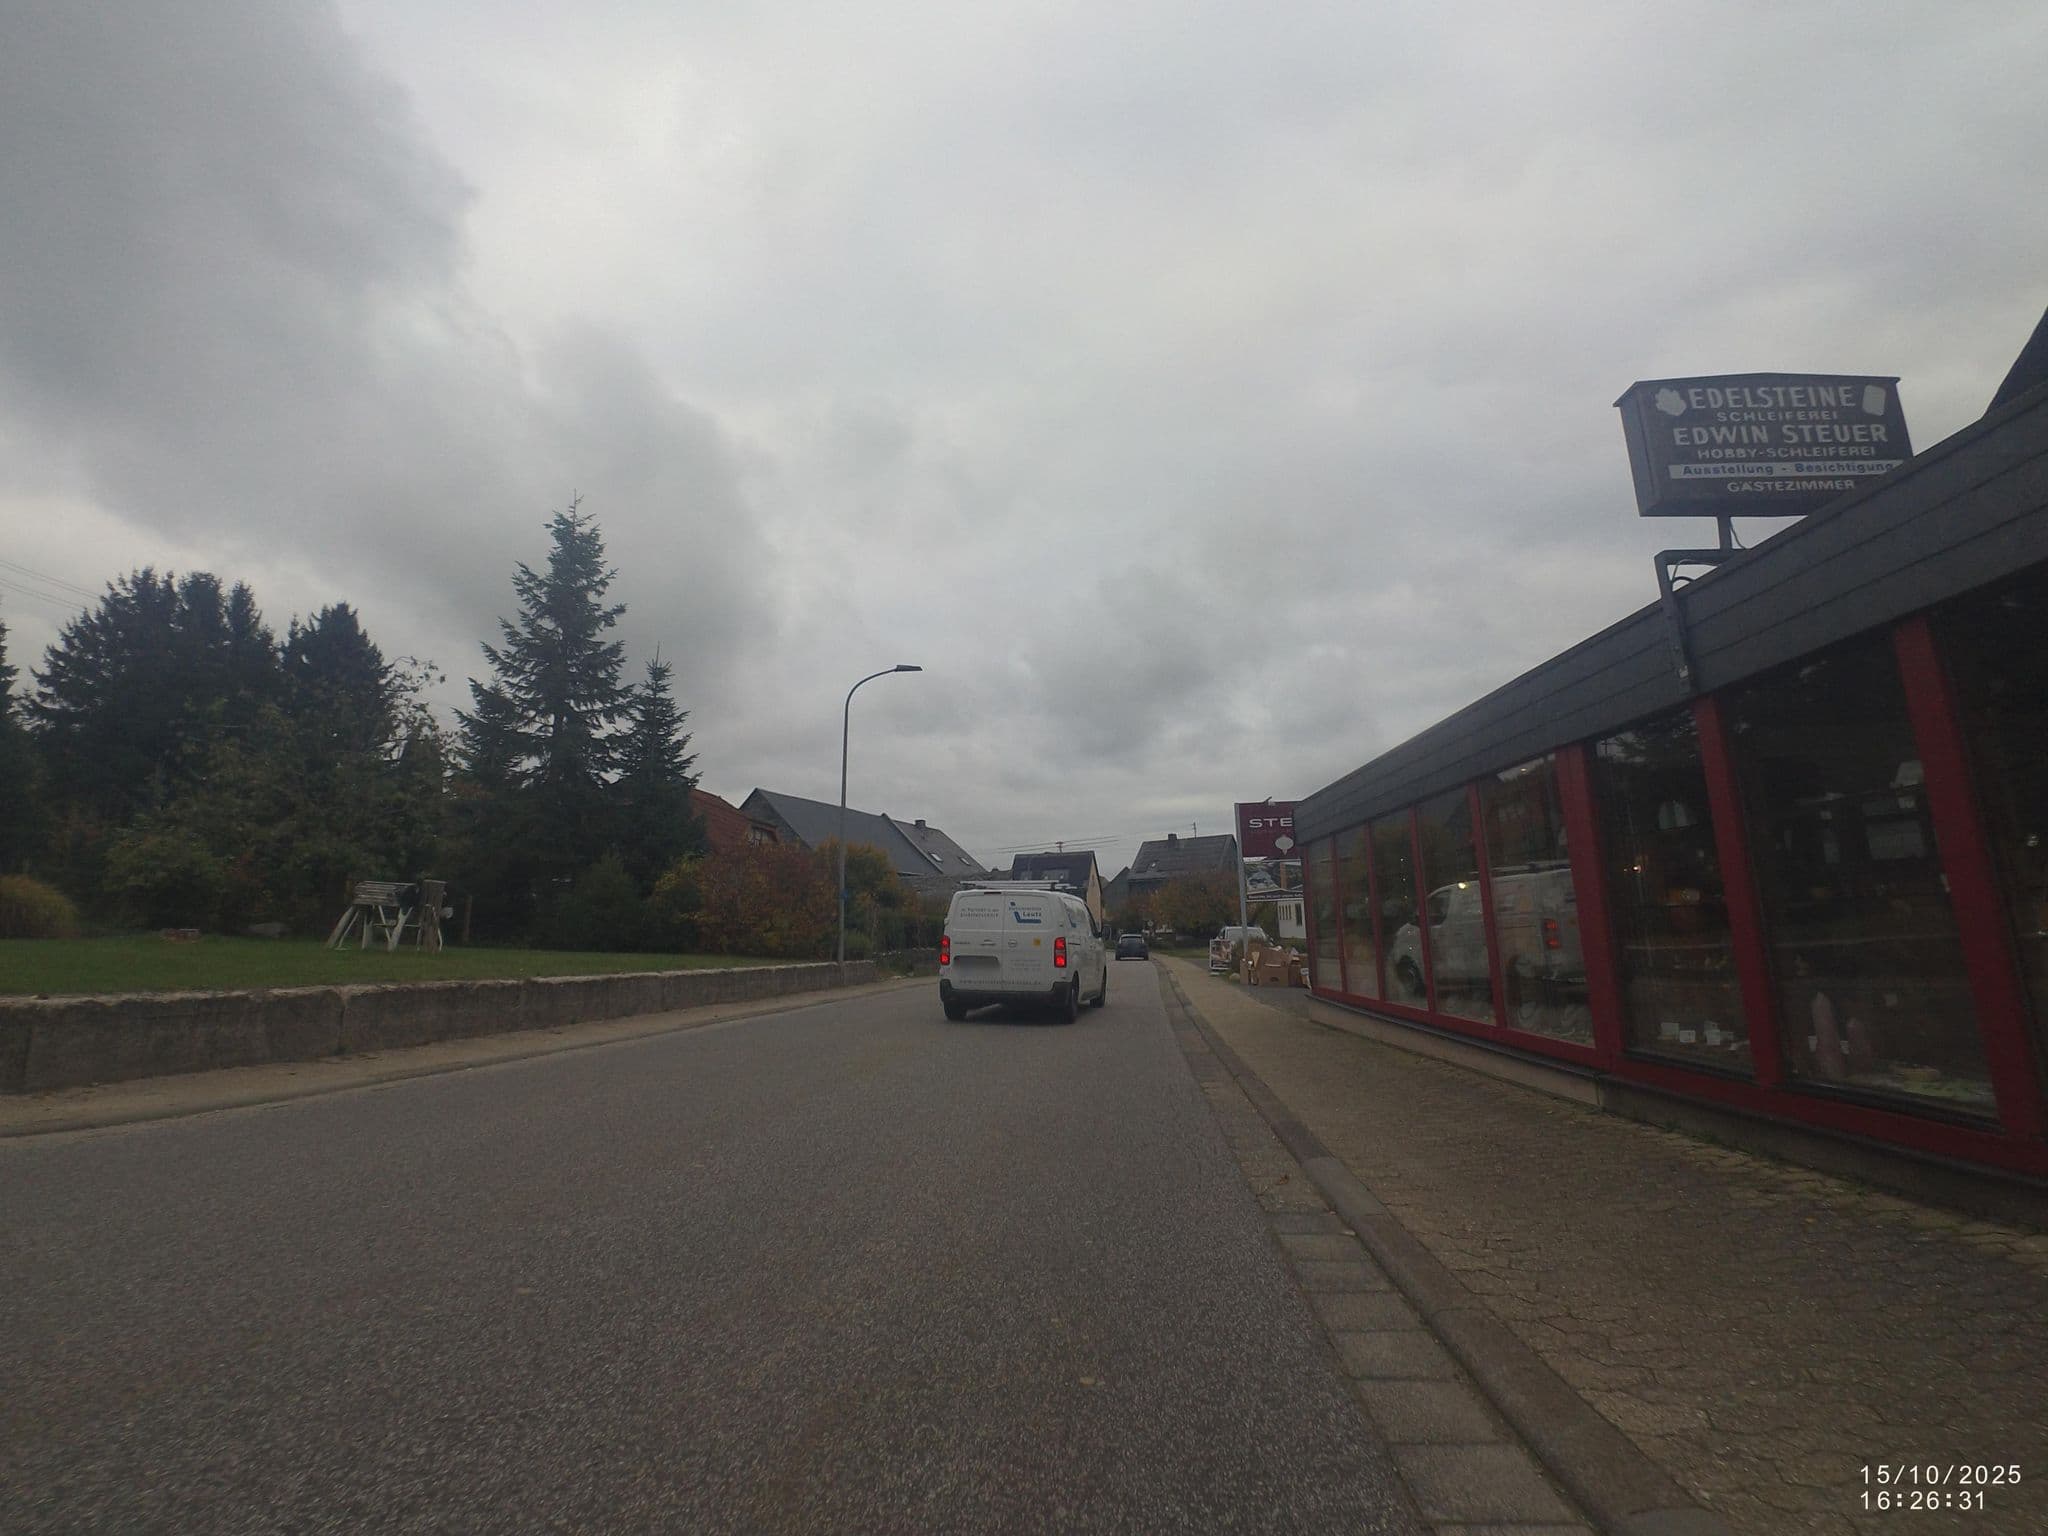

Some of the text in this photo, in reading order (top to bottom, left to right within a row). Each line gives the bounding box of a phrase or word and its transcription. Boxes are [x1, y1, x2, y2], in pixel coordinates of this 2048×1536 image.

[1688, 385, 1857, 409] EDELSTEINE
[1716, 410, 1838, 422] SCHLEIFEREI
[1673, 423, 1888, 446] EDWIN STEUER
[1698, 446, 1876, 460] HOBBY-SCHLEIFEREI
[1682, 463, 1774, 476] Ausstellung
[1794, 461, 1894, 475] Besichtigung
[1727, 478, 1856, 493] GÄSTEZIMMER
